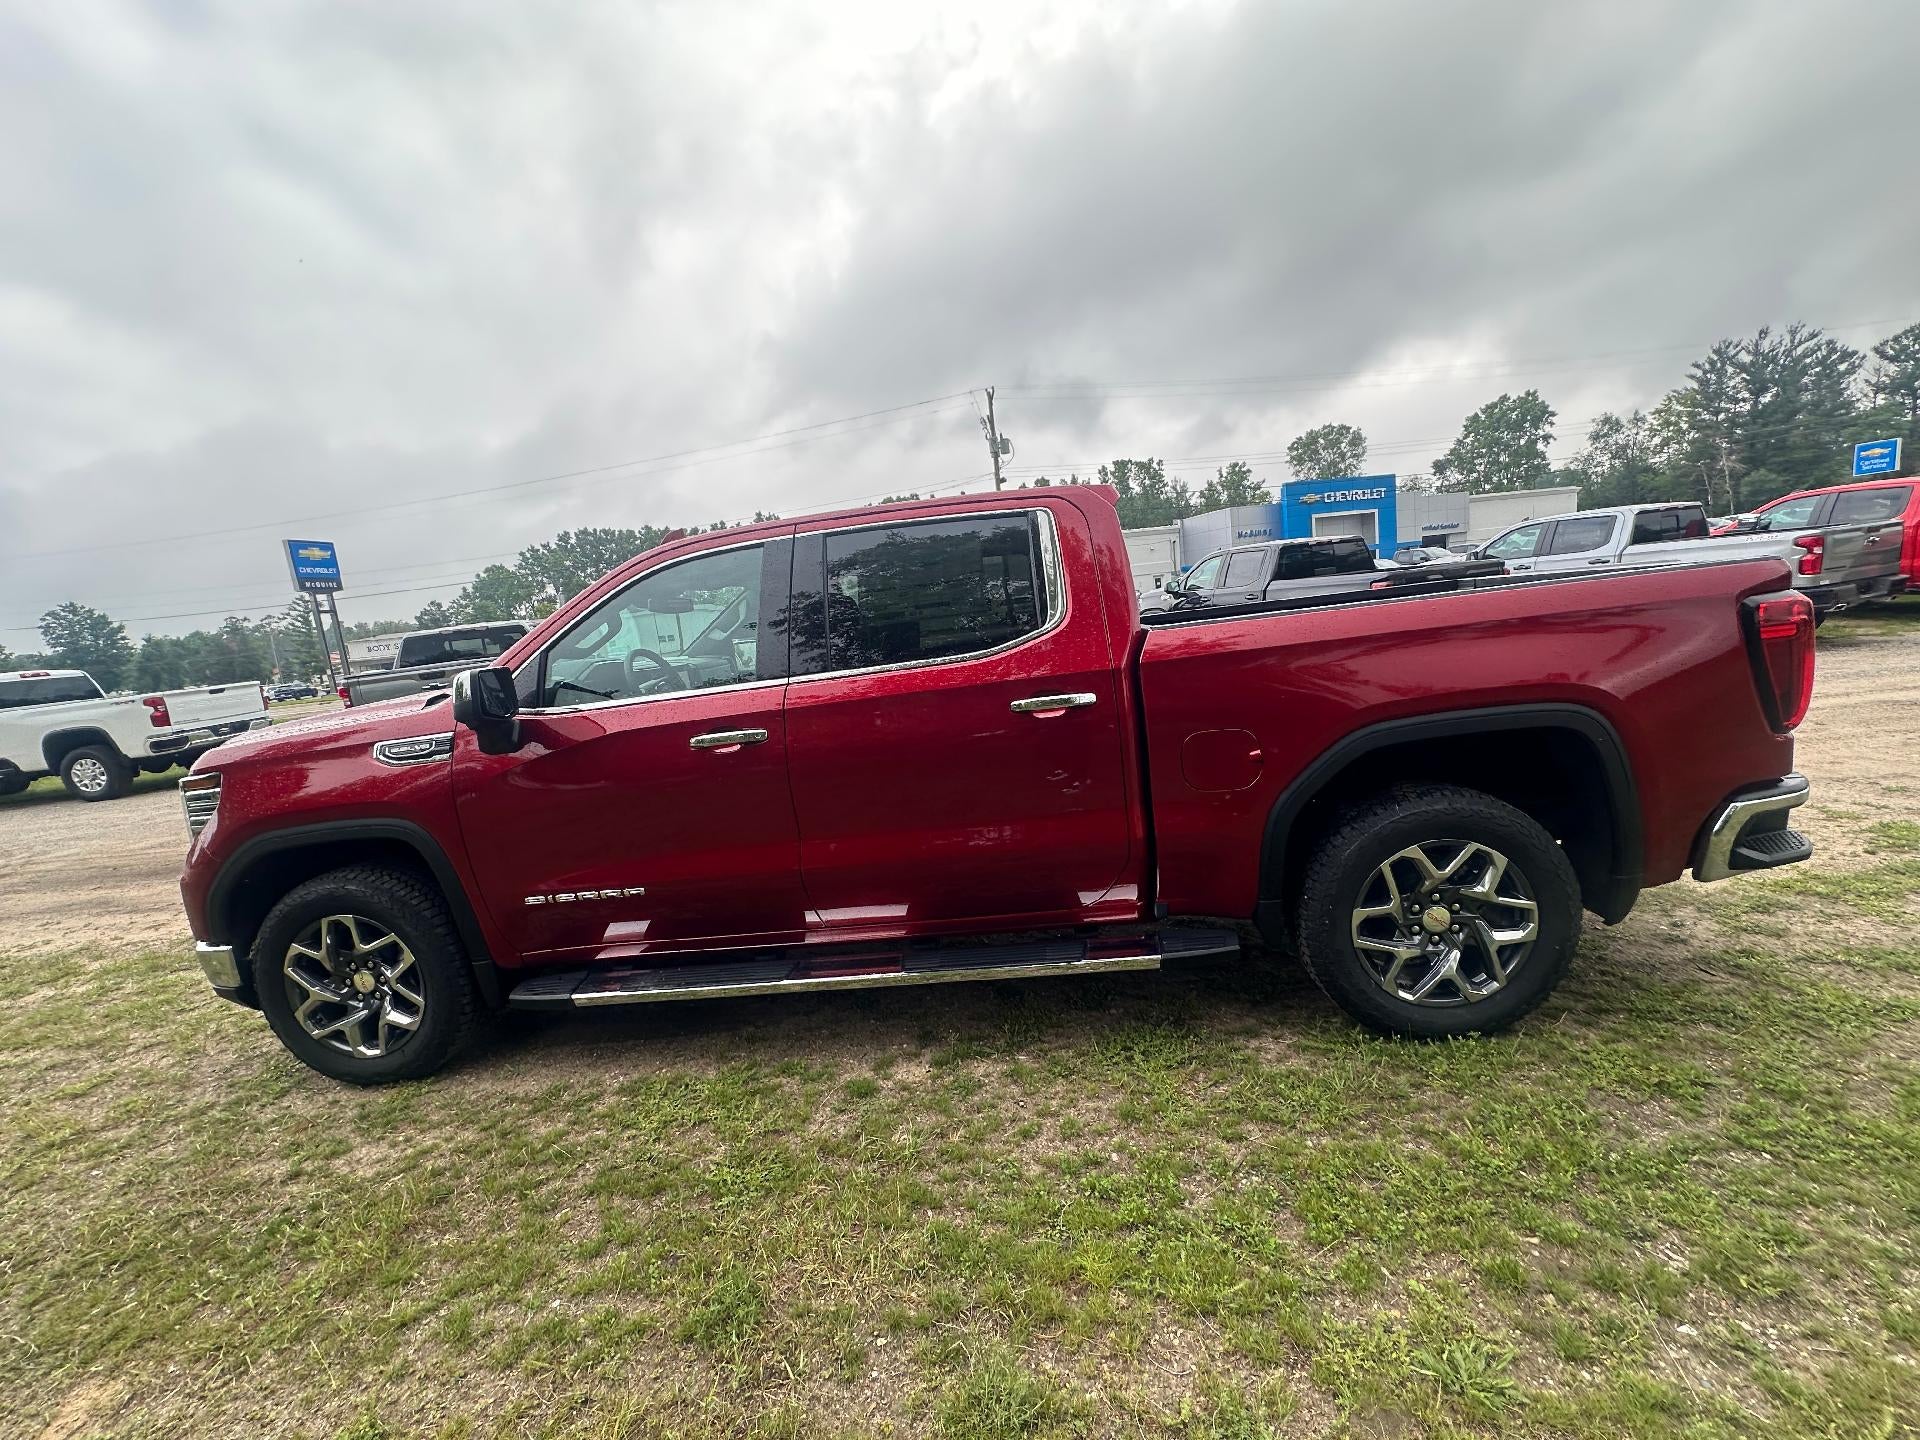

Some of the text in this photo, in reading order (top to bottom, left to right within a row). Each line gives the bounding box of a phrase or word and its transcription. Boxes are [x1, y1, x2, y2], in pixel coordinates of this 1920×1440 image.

[1324, 488, 1387, 503] CHEVROLET
[299, 566, 337, 574] CHEVROLET
[366, 643, 391, 653] BODY
[524, 887, 646, 905] SIERRA
[1427, 912, 1448, 928] GMC
